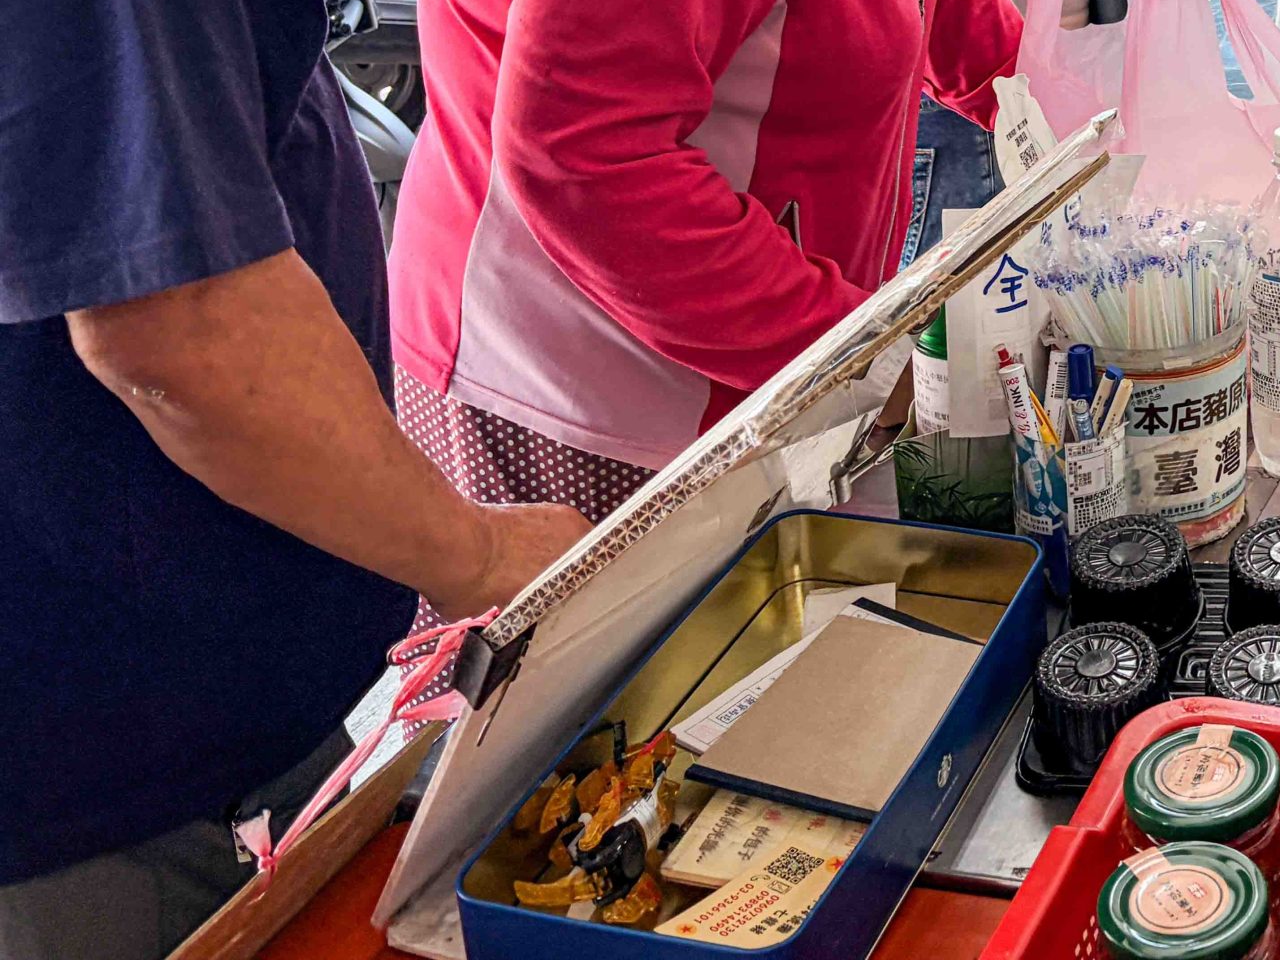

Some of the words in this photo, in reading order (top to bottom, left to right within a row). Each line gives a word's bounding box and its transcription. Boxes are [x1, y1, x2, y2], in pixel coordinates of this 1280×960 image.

[1133, 373, 1246, 436] 本店豬原
[1153, 426, 1241, 497] 臺灣
[694, 882, 755, 925] 03-9366101
